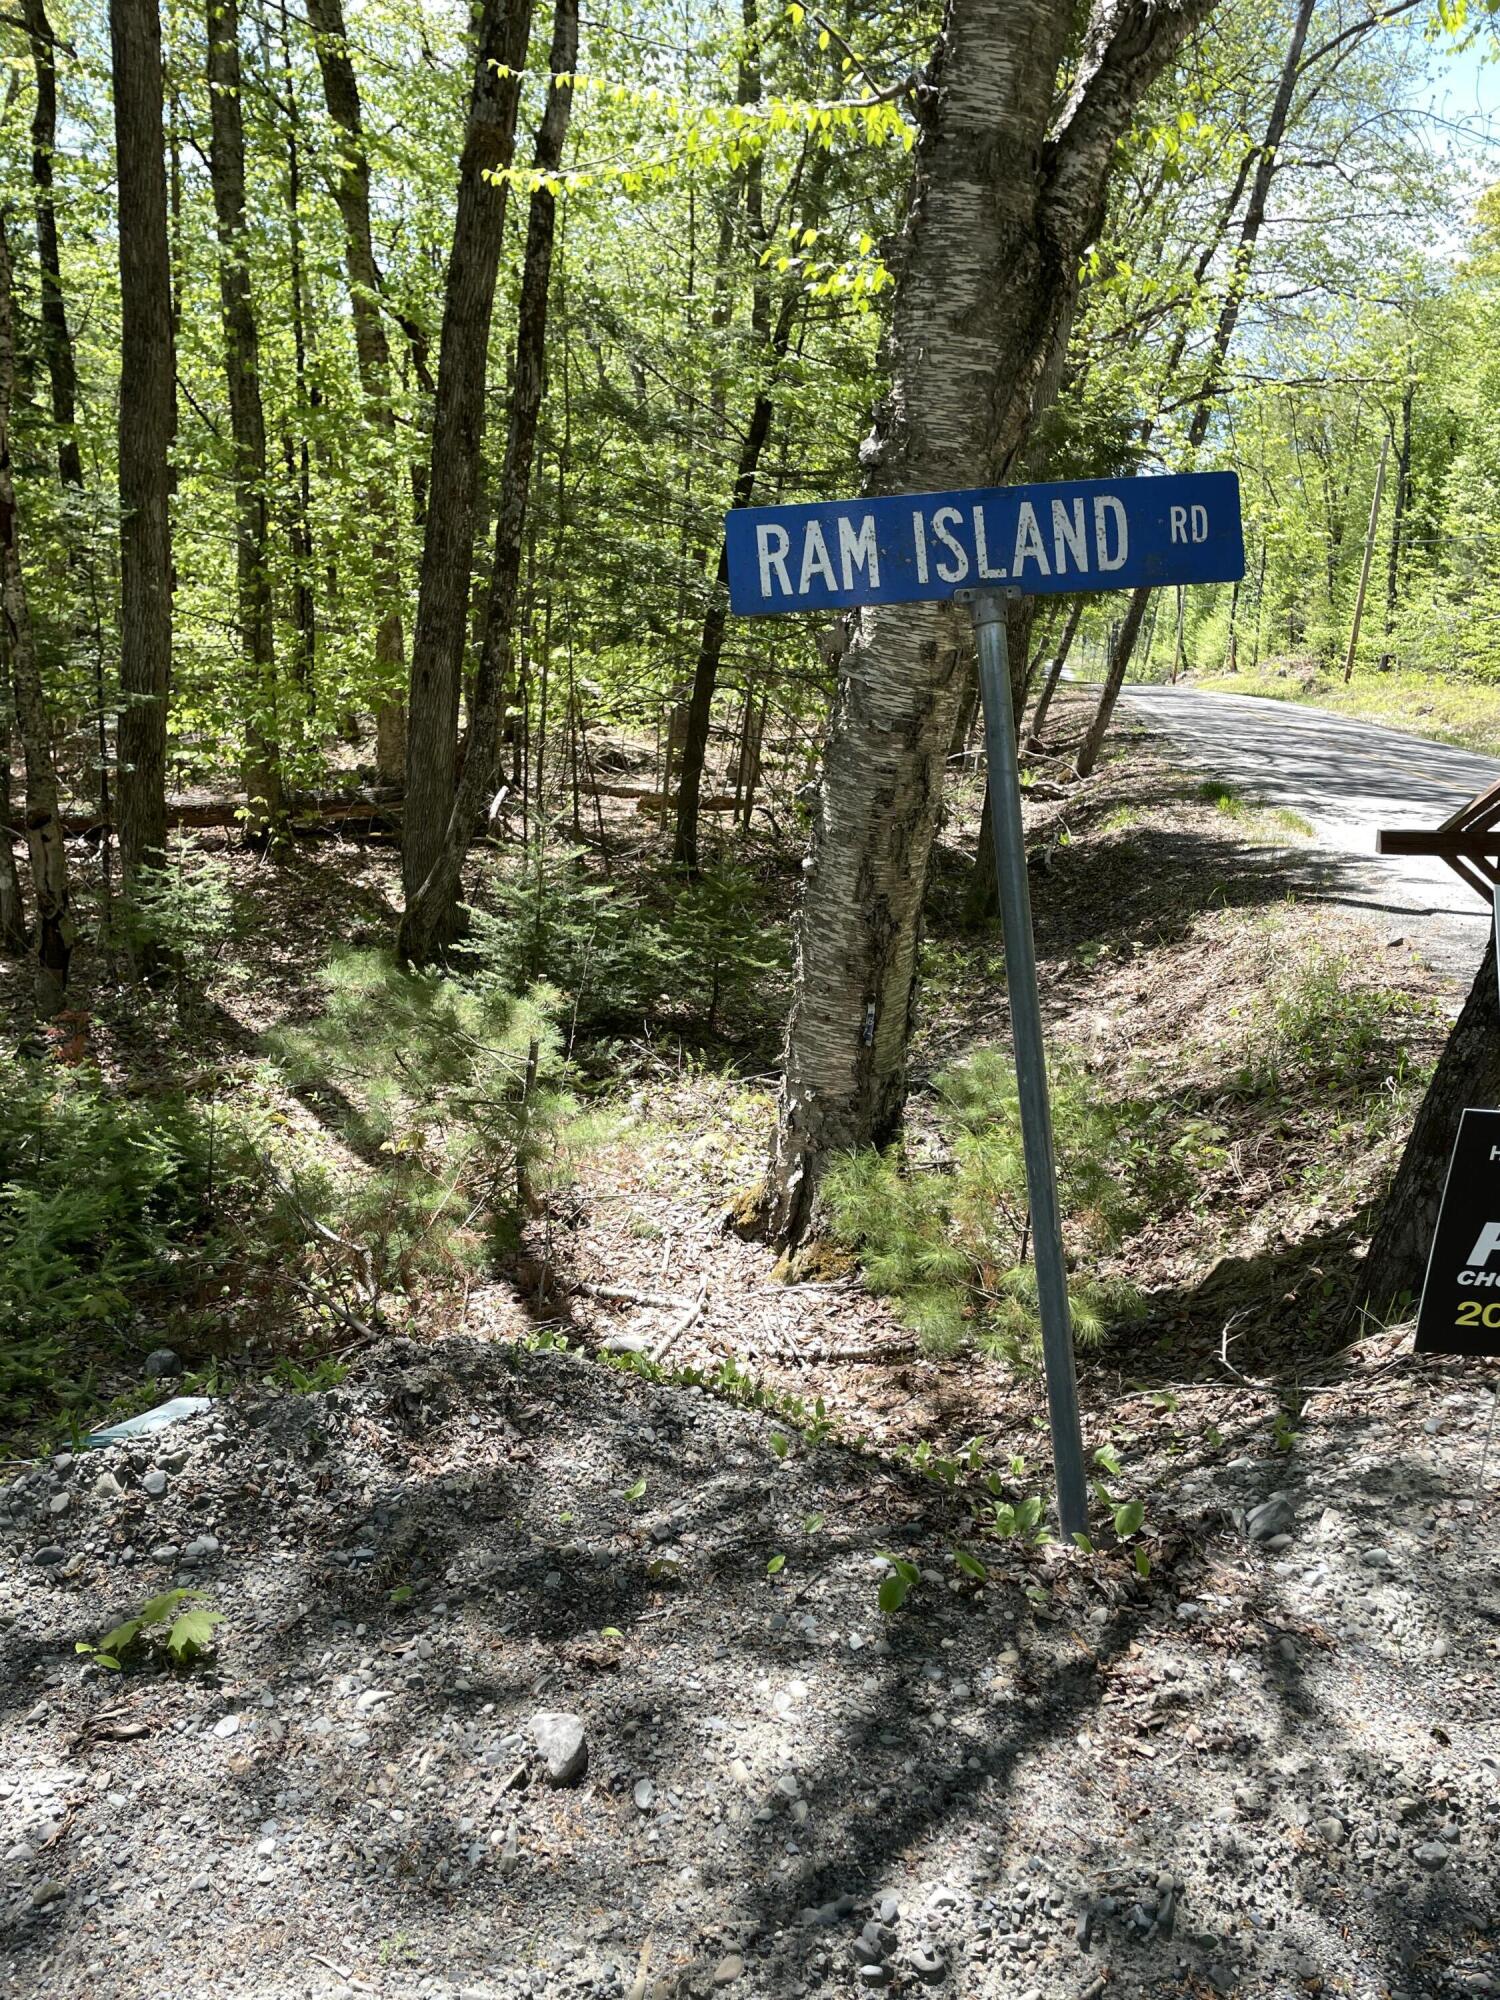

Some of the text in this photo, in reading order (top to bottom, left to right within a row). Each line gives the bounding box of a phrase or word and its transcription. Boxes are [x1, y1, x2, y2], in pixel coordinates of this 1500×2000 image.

[756, 495, 1209, 598] RAM ISLAND RD
